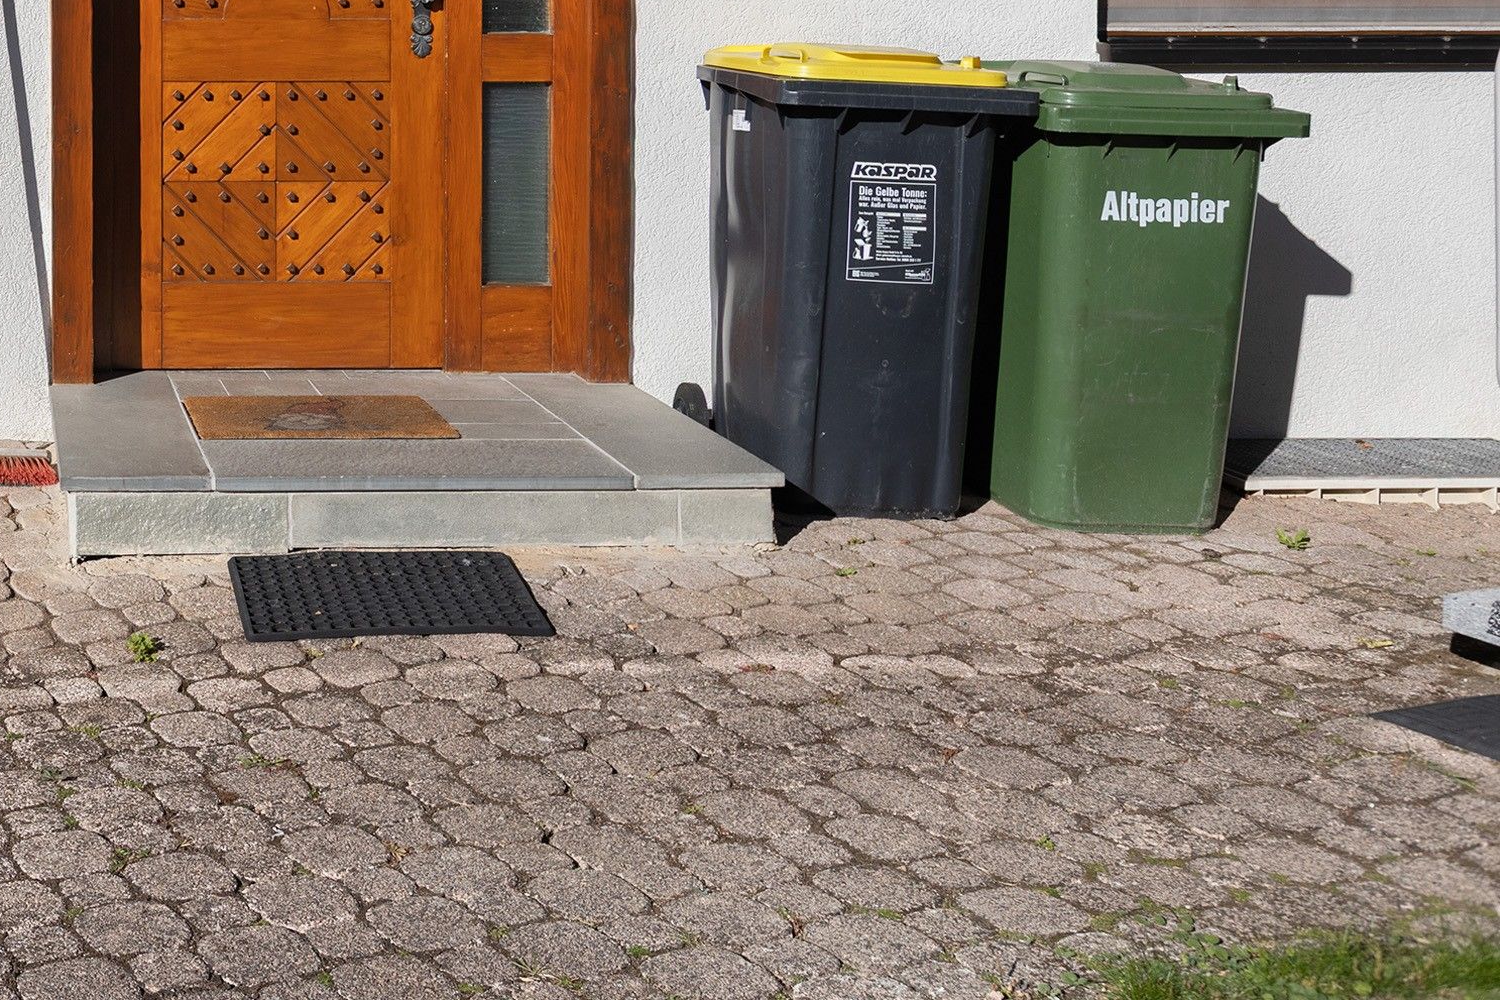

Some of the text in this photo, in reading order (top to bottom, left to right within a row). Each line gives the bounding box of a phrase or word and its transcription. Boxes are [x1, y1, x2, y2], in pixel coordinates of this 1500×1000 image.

[858, 186, 928, 198] Die Gelbe Tonne:
[1100, 190, 1230, 227] Altpapier
